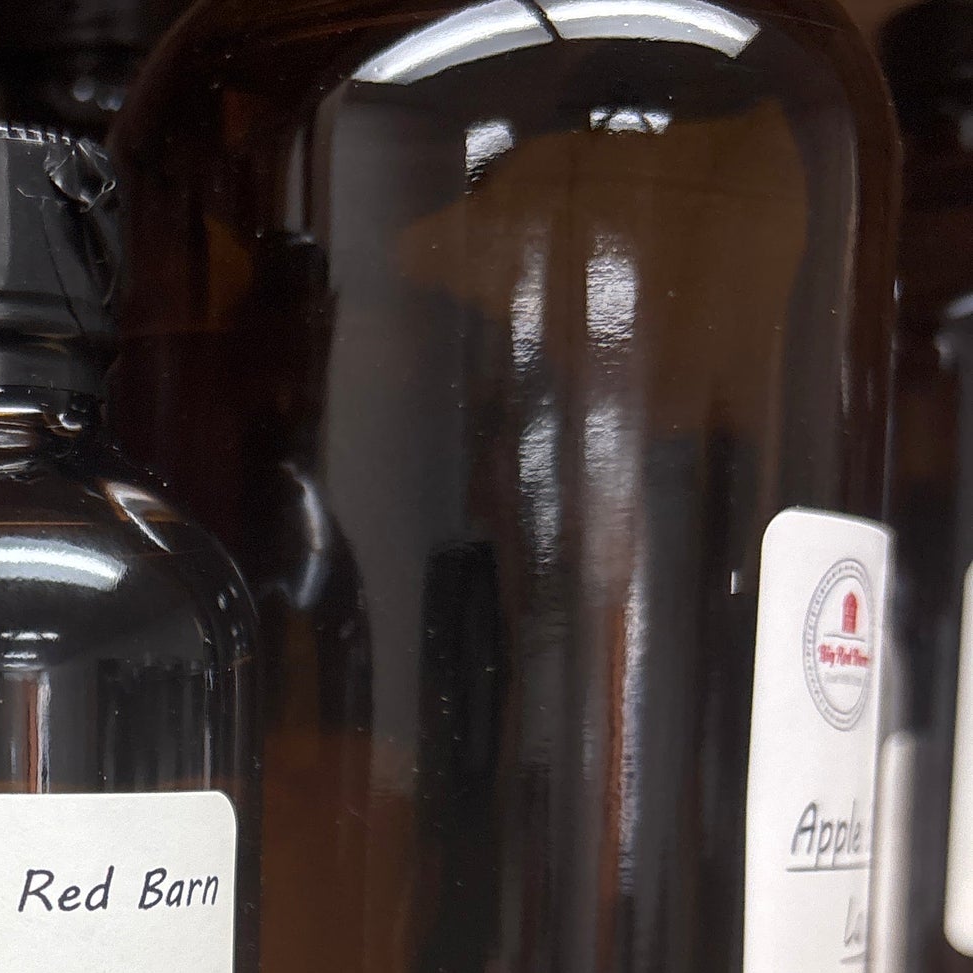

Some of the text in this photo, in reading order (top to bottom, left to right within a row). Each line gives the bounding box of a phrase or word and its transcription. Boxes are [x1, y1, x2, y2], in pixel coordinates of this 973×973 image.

[790, 801, 861, 868] Apple
[18, 866, 115, 913] Red
[138, 867, 219, 910] Barn
